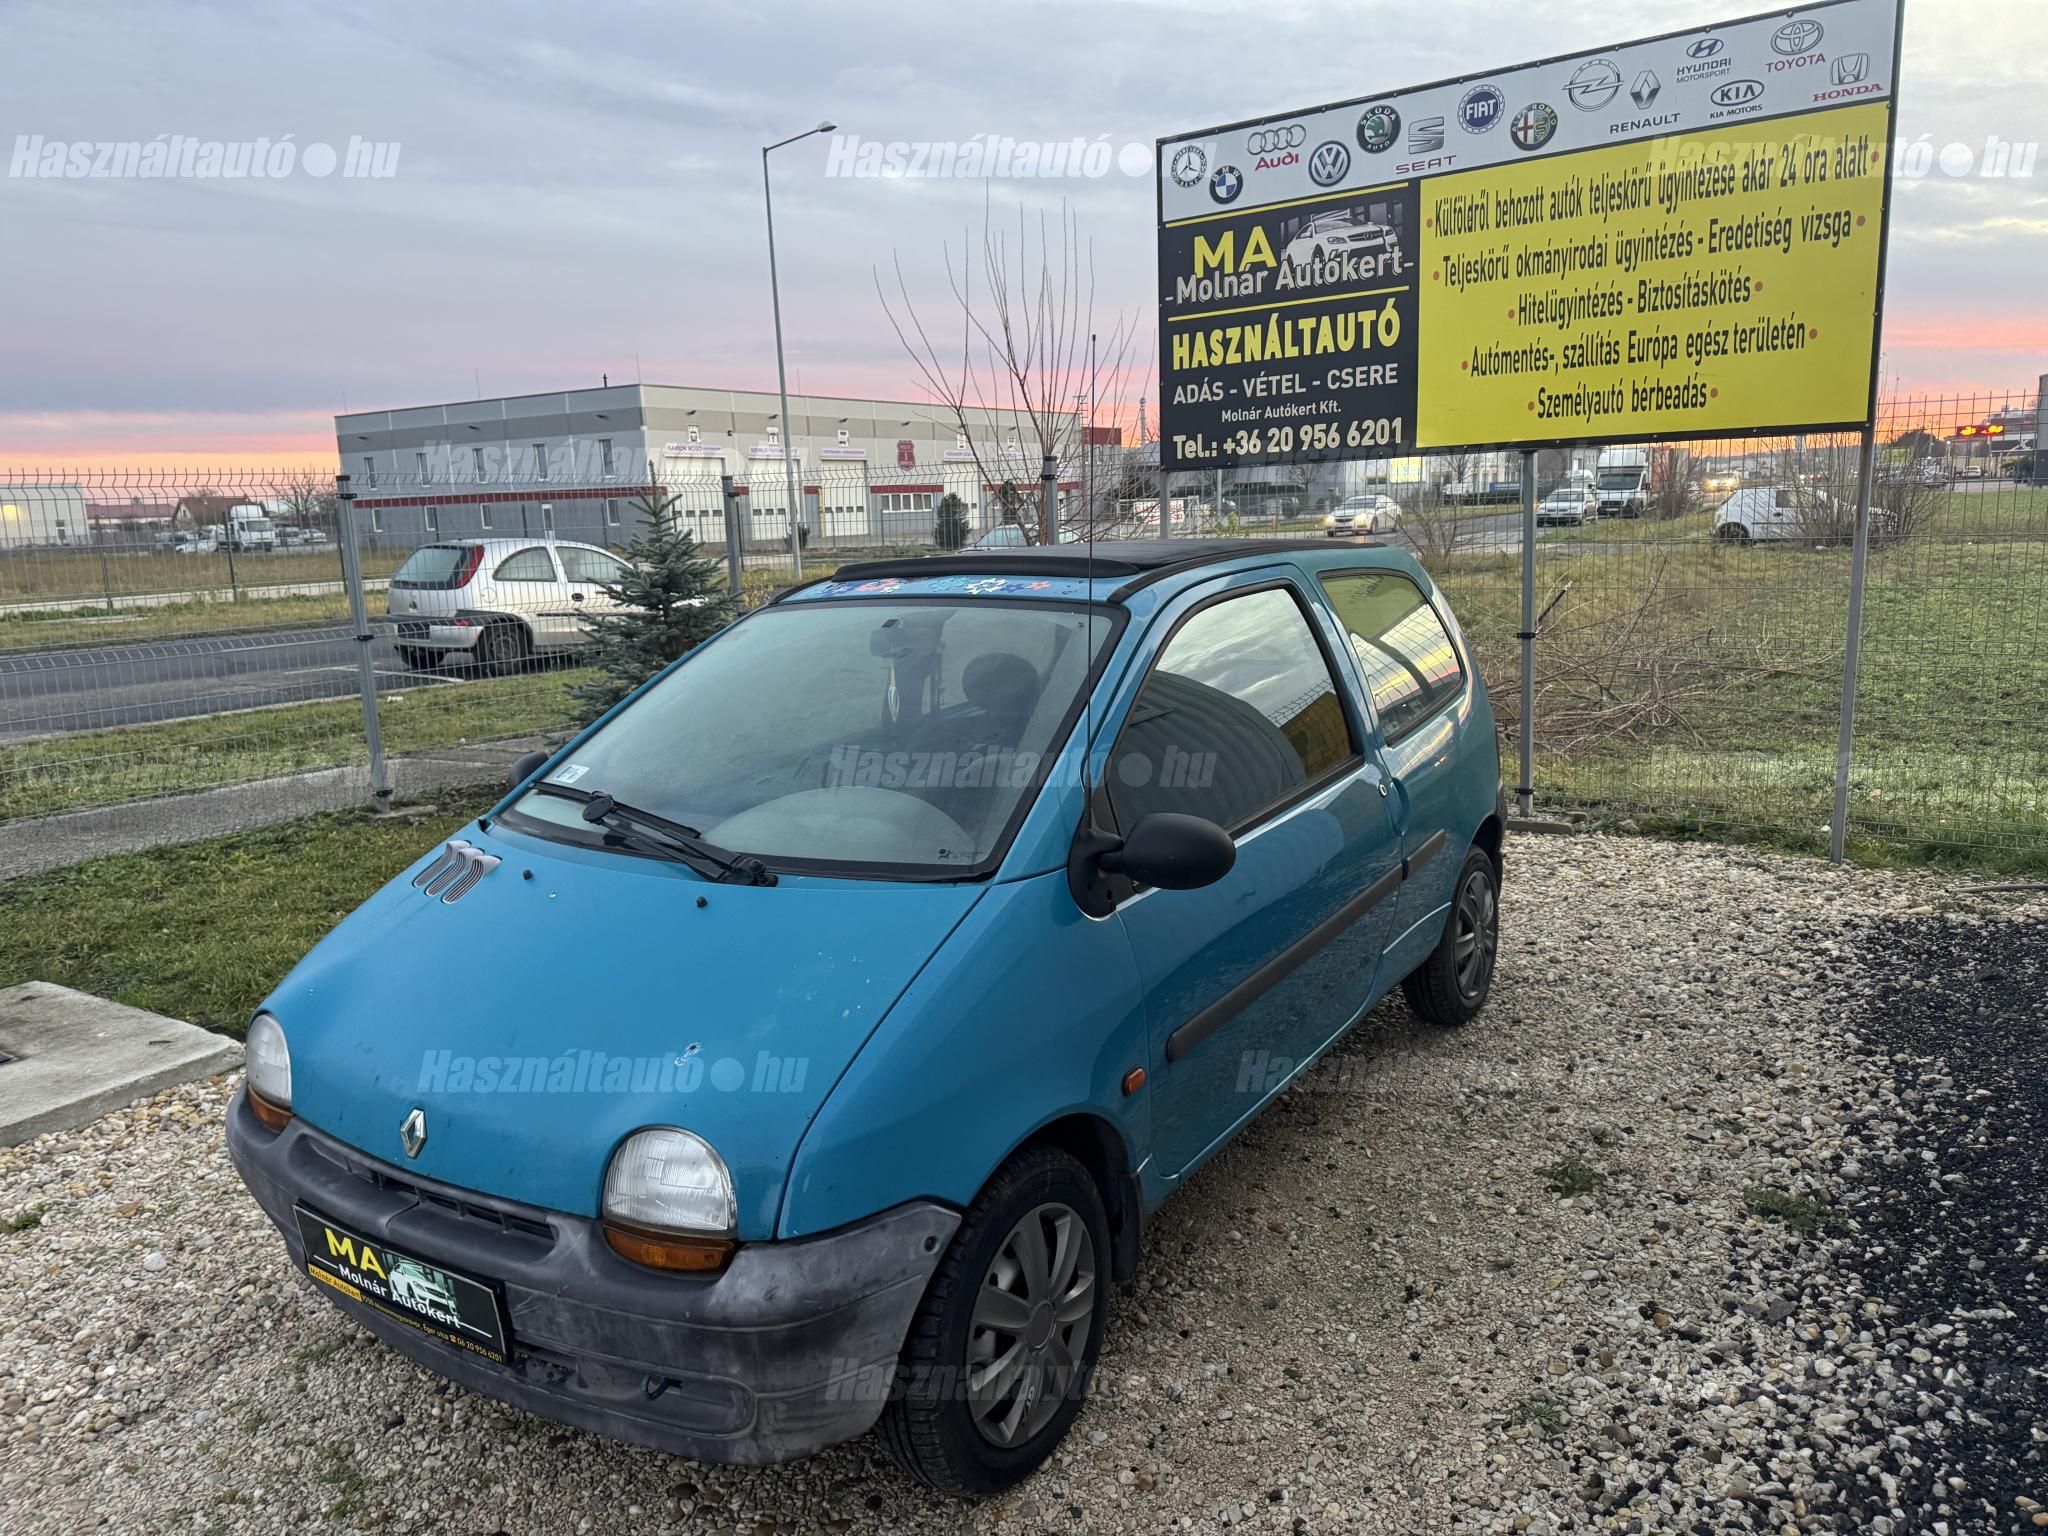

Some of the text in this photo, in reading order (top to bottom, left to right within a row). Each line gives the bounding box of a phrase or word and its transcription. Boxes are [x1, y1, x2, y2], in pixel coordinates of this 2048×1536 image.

[1676, 58, 1731, 75] HYUNDAI
[1676, 67, 1731, 83] MOTORSPORT
[1765, 53, 1826, 73] TOYOTA
[1719, 84, 1755, 102] KIA
[1812, 83, 1883, 102] HONDA
[1466, 98, 1496, 119] FIAT
[1709, 104, 1763, 120] KIA MOTORS
[1609, 113, 1681, 134] RENAULT
[1254, 153, 1300, 171] Audi
[1395, 155, 1456, 174] SEAT
[1435, 134, 1869, 238] Külföldről behozott autók teljeskörű ügyintézése akár 24 óra alatt
[1194, 225, 1277, 278] MA
[1443, 244, 1510, 293] Teljeskörű
[1516, 233, 1608, 280] okmányirodai
[1615, 220, 1693, 273] ügyintézés
[1708, 206, 1792, 254] Eredetiség
[1801, 205, 1851, 248] vizsga
[1518, 280, 1623, 330] Hitelügyintézés
[1638, 265, 1751, 314] Biztosításkötés
[1172, 297, 1400, 370] HASZNÁLTAUTÓ
[1562, 330, 1620, 370] szállítás
[1627, 325, 1678, 369] Európa
[1686, 320, 1729, 366] egész
[1733, 312, 1805, 355] területén
[1173, 377, 1223, 405] ADÁS
[1243, 372, 1306, 398] VÉTEL
[1327, 363, 1398, 390] CSERE
[1537, 372, 1707, 423] Személyautó bérbeadás
[1221, 400, 1341, 423] Molnár Autókert Kft.
[1173, 417, 1402, 460] Tel.: +36 20 956 6201
[325, 1227, 388, 1280] MA
[338, 1263, 388, 1297] Molnár
